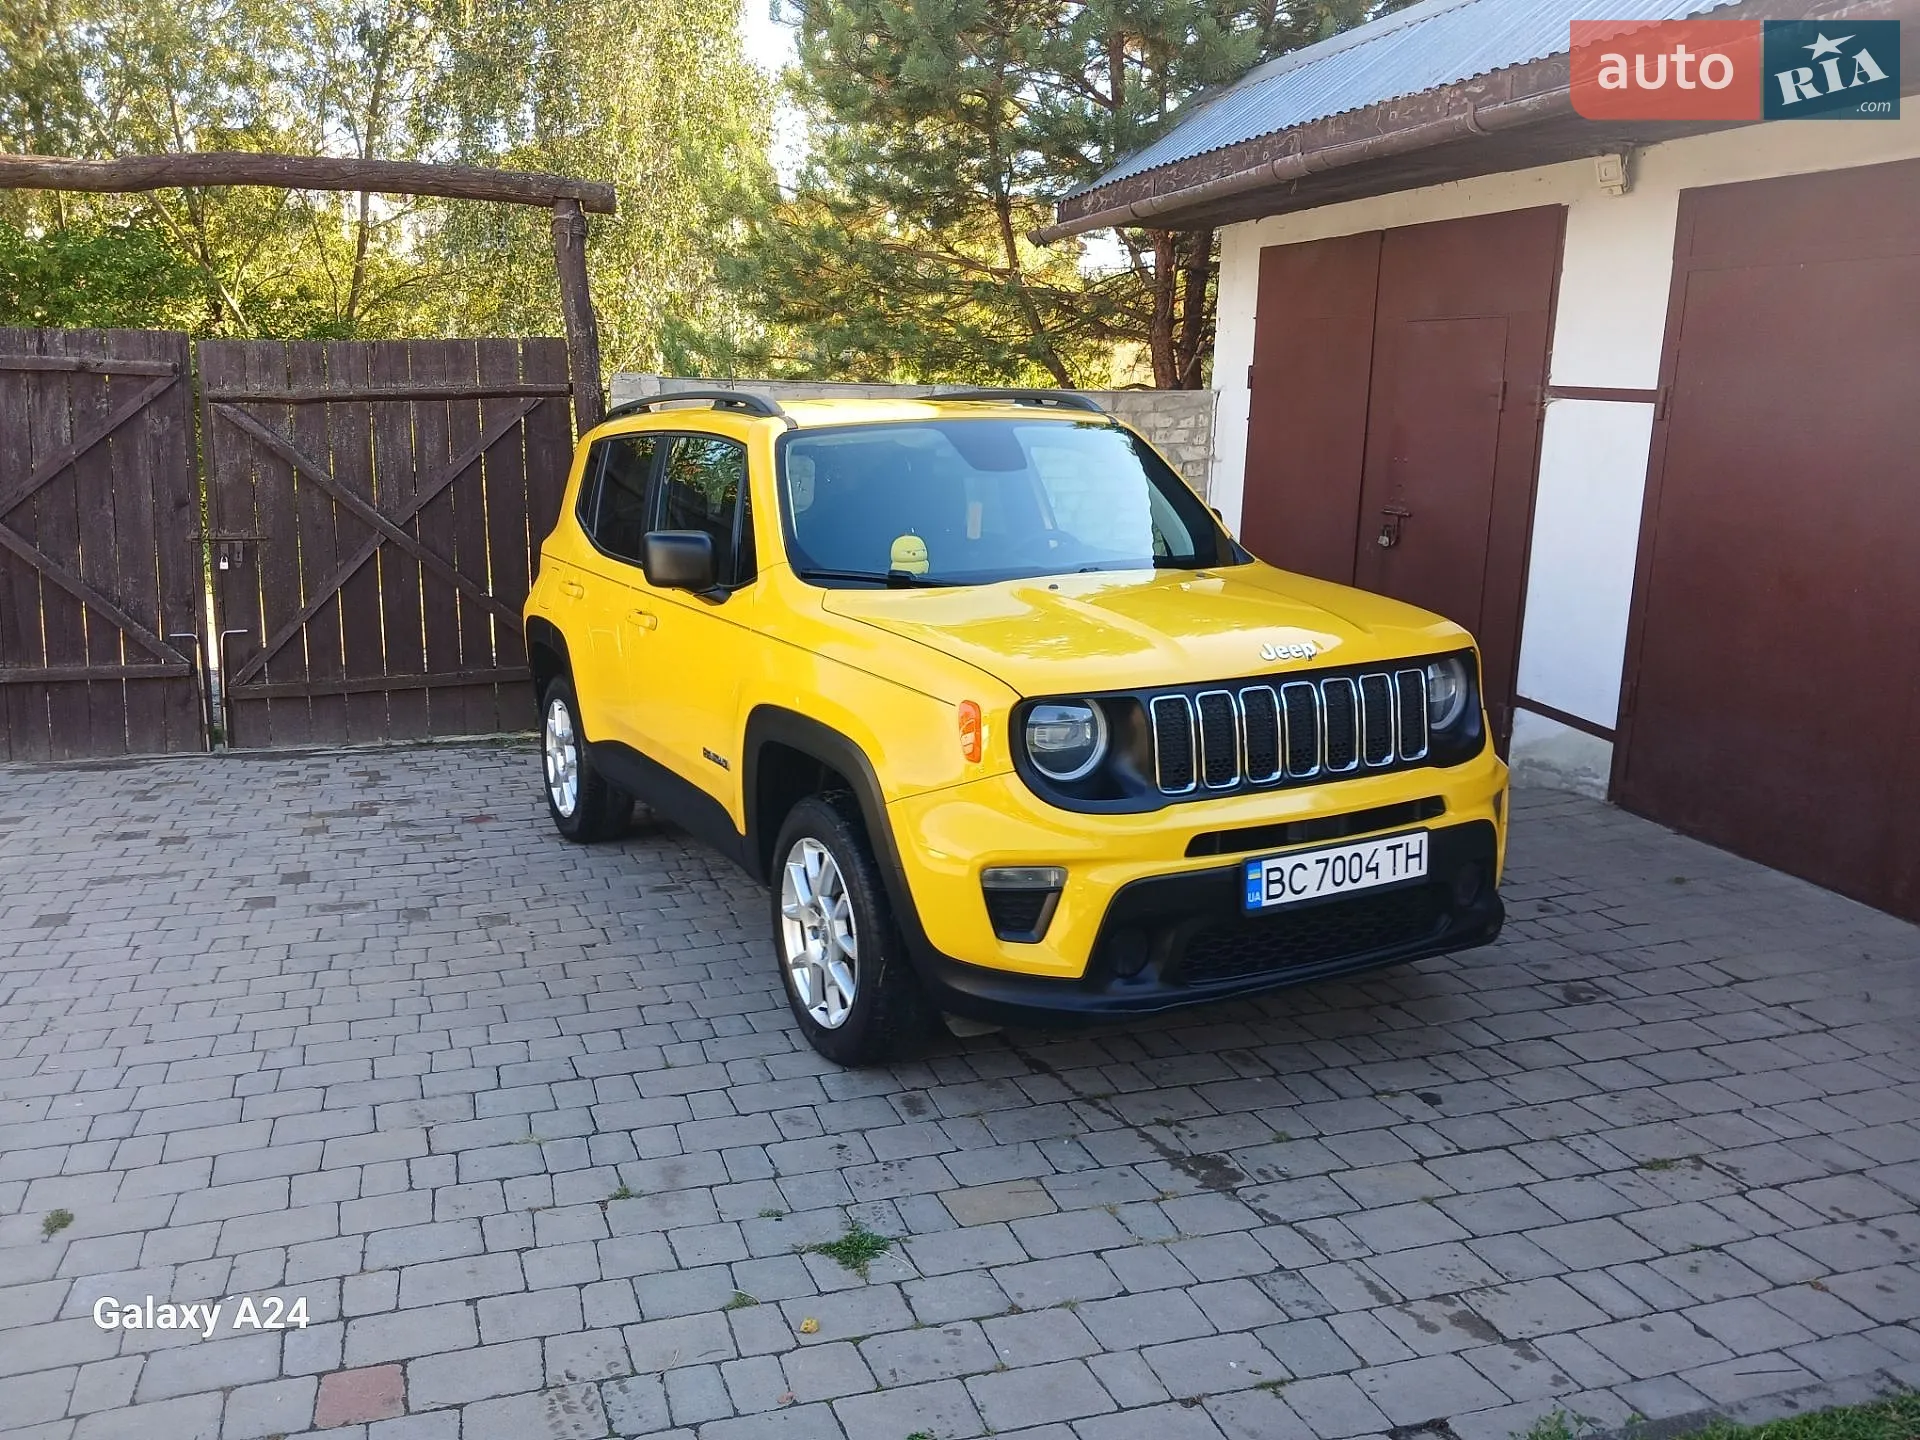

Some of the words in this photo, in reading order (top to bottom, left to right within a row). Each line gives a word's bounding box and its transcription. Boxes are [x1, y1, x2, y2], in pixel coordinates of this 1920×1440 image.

[1260, 642, 1317, 661] Jeep
[1266, 863, 1308, 900] BC
[1315, 848, 1379, 891] 7004
[1387, 839, 1423, 876] TH
[1248, 892, 1261, 902] UA
